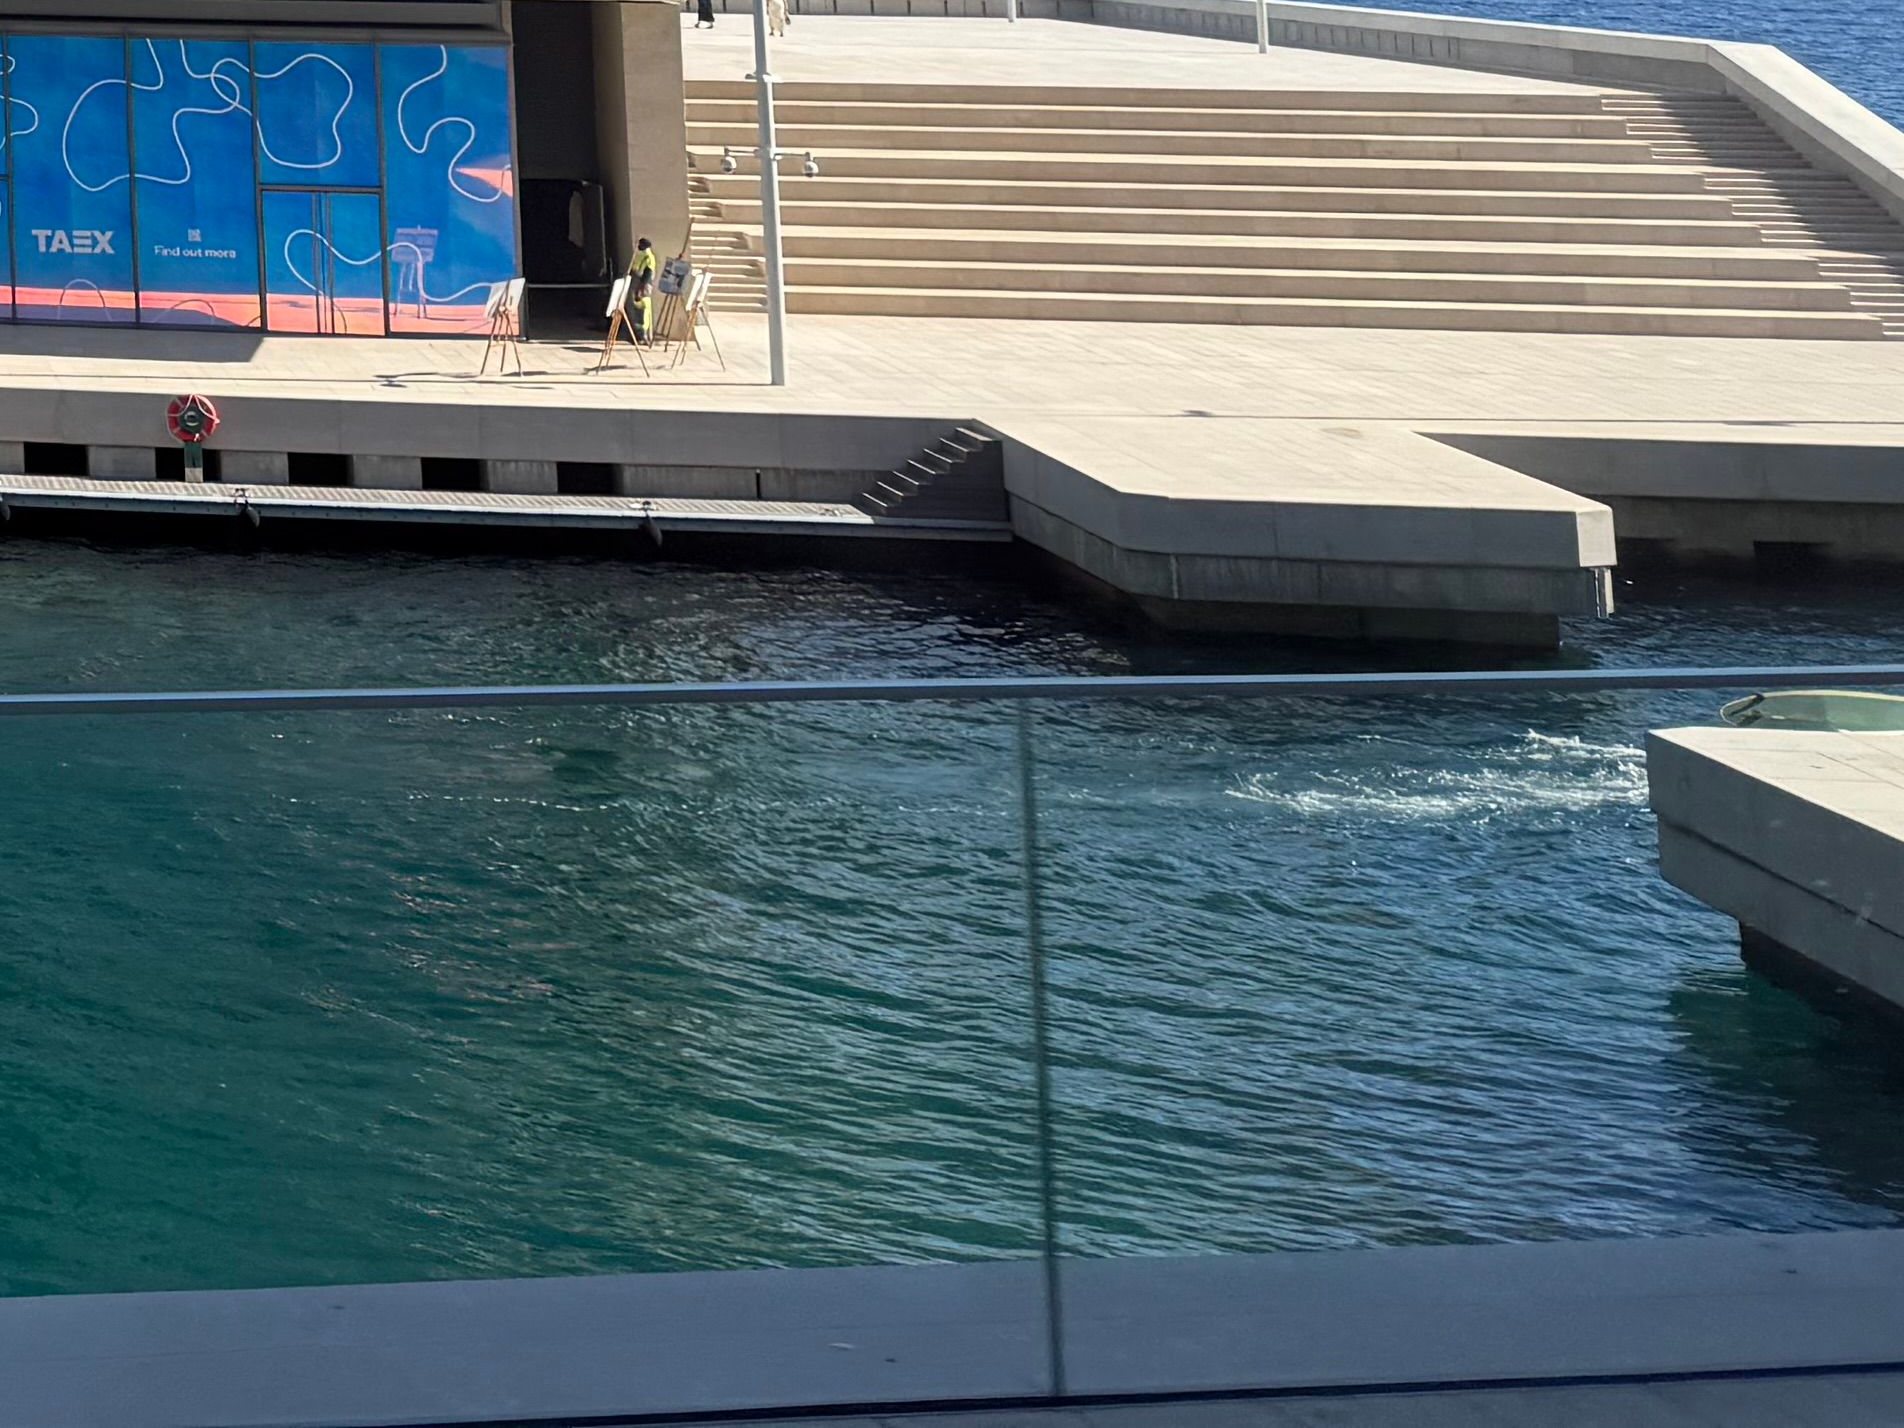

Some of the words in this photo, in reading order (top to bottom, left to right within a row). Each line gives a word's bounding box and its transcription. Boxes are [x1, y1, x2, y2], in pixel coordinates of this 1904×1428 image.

[31, 229, 115, 254] TAEX
[154, 245, 180, 257] Find
[182, 247, 203, 257] out
[205, 249, 237, 259] more
